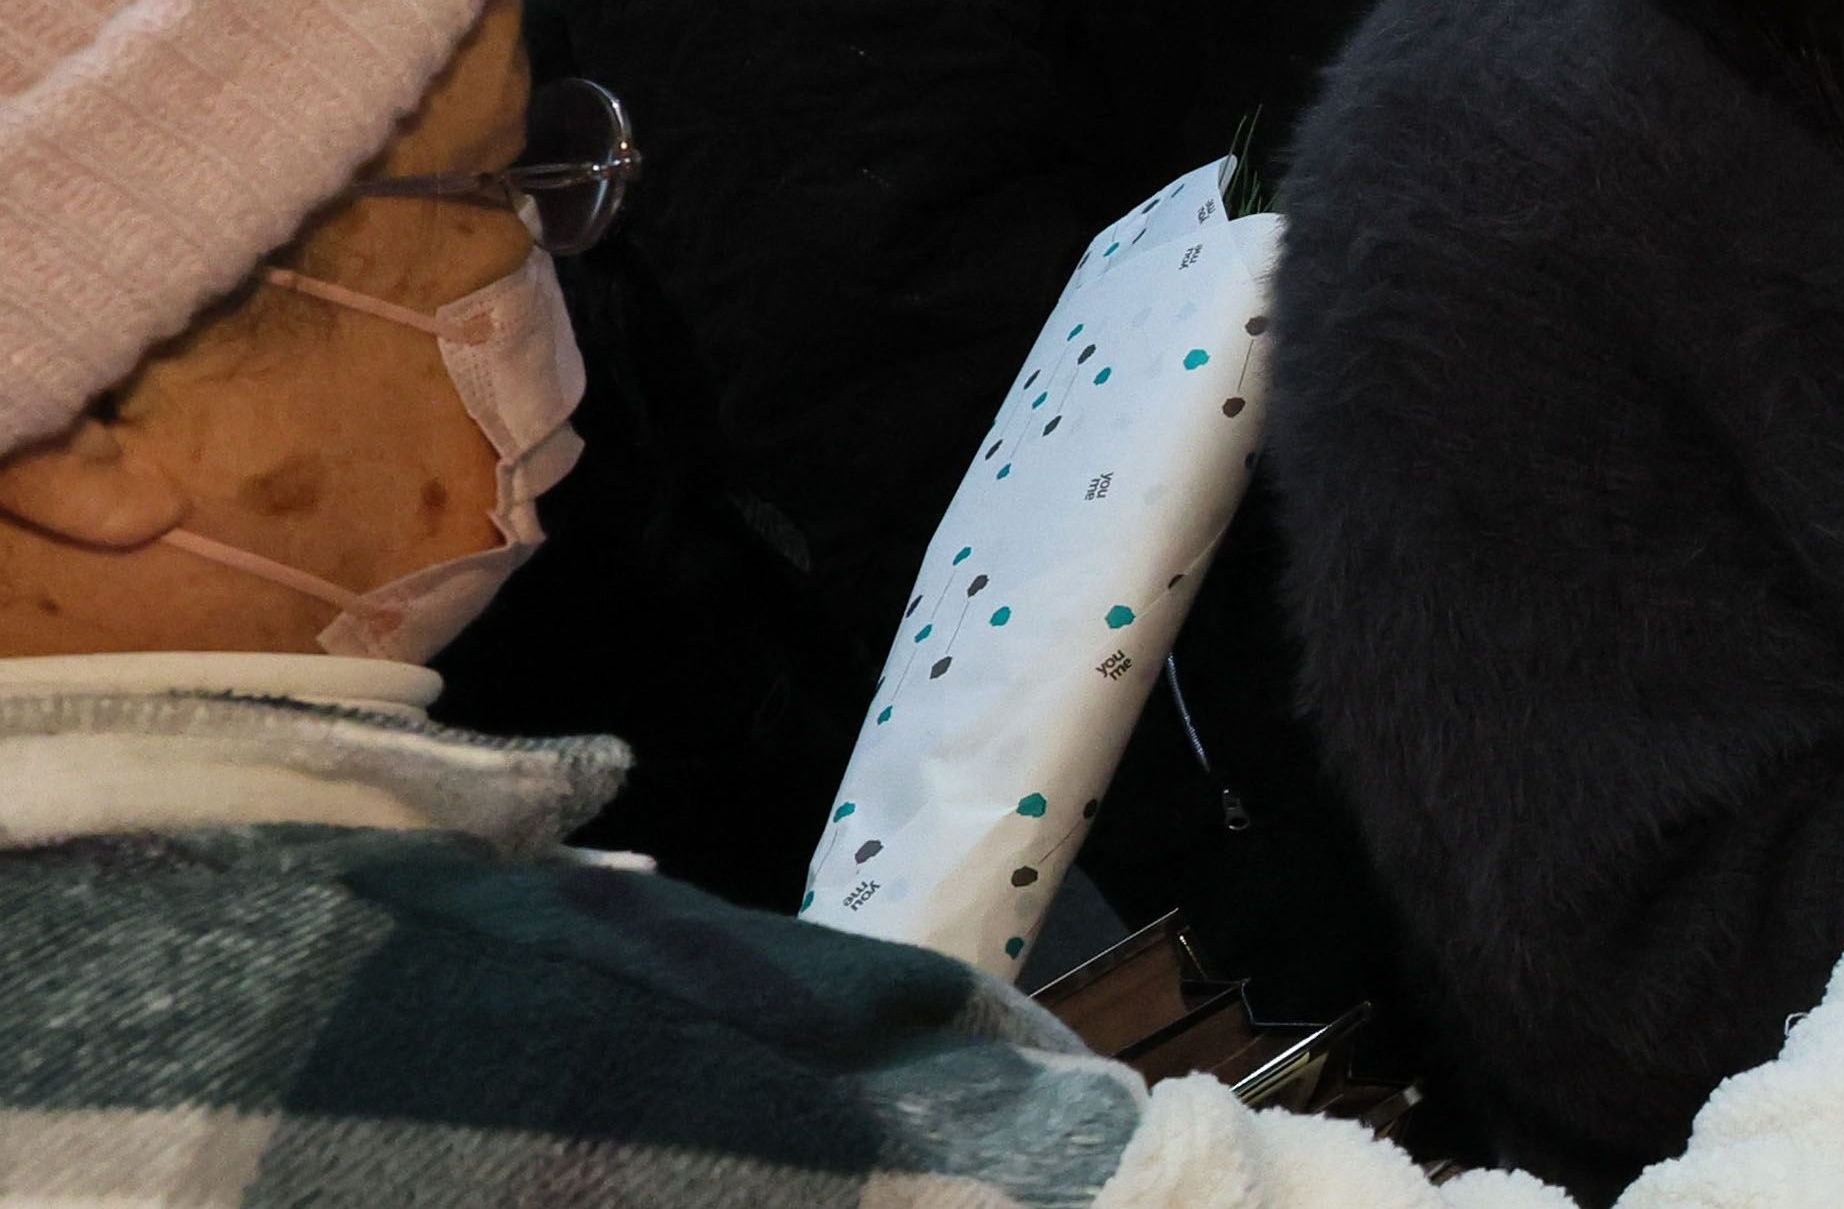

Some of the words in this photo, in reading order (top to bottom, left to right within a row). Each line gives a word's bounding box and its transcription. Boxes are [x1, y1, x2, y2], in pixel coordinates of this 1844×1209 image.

[1096, 471, 1115, 499] you
[1095, 648, 1126, 679] you
[1108, 657, 1133, 681] me
